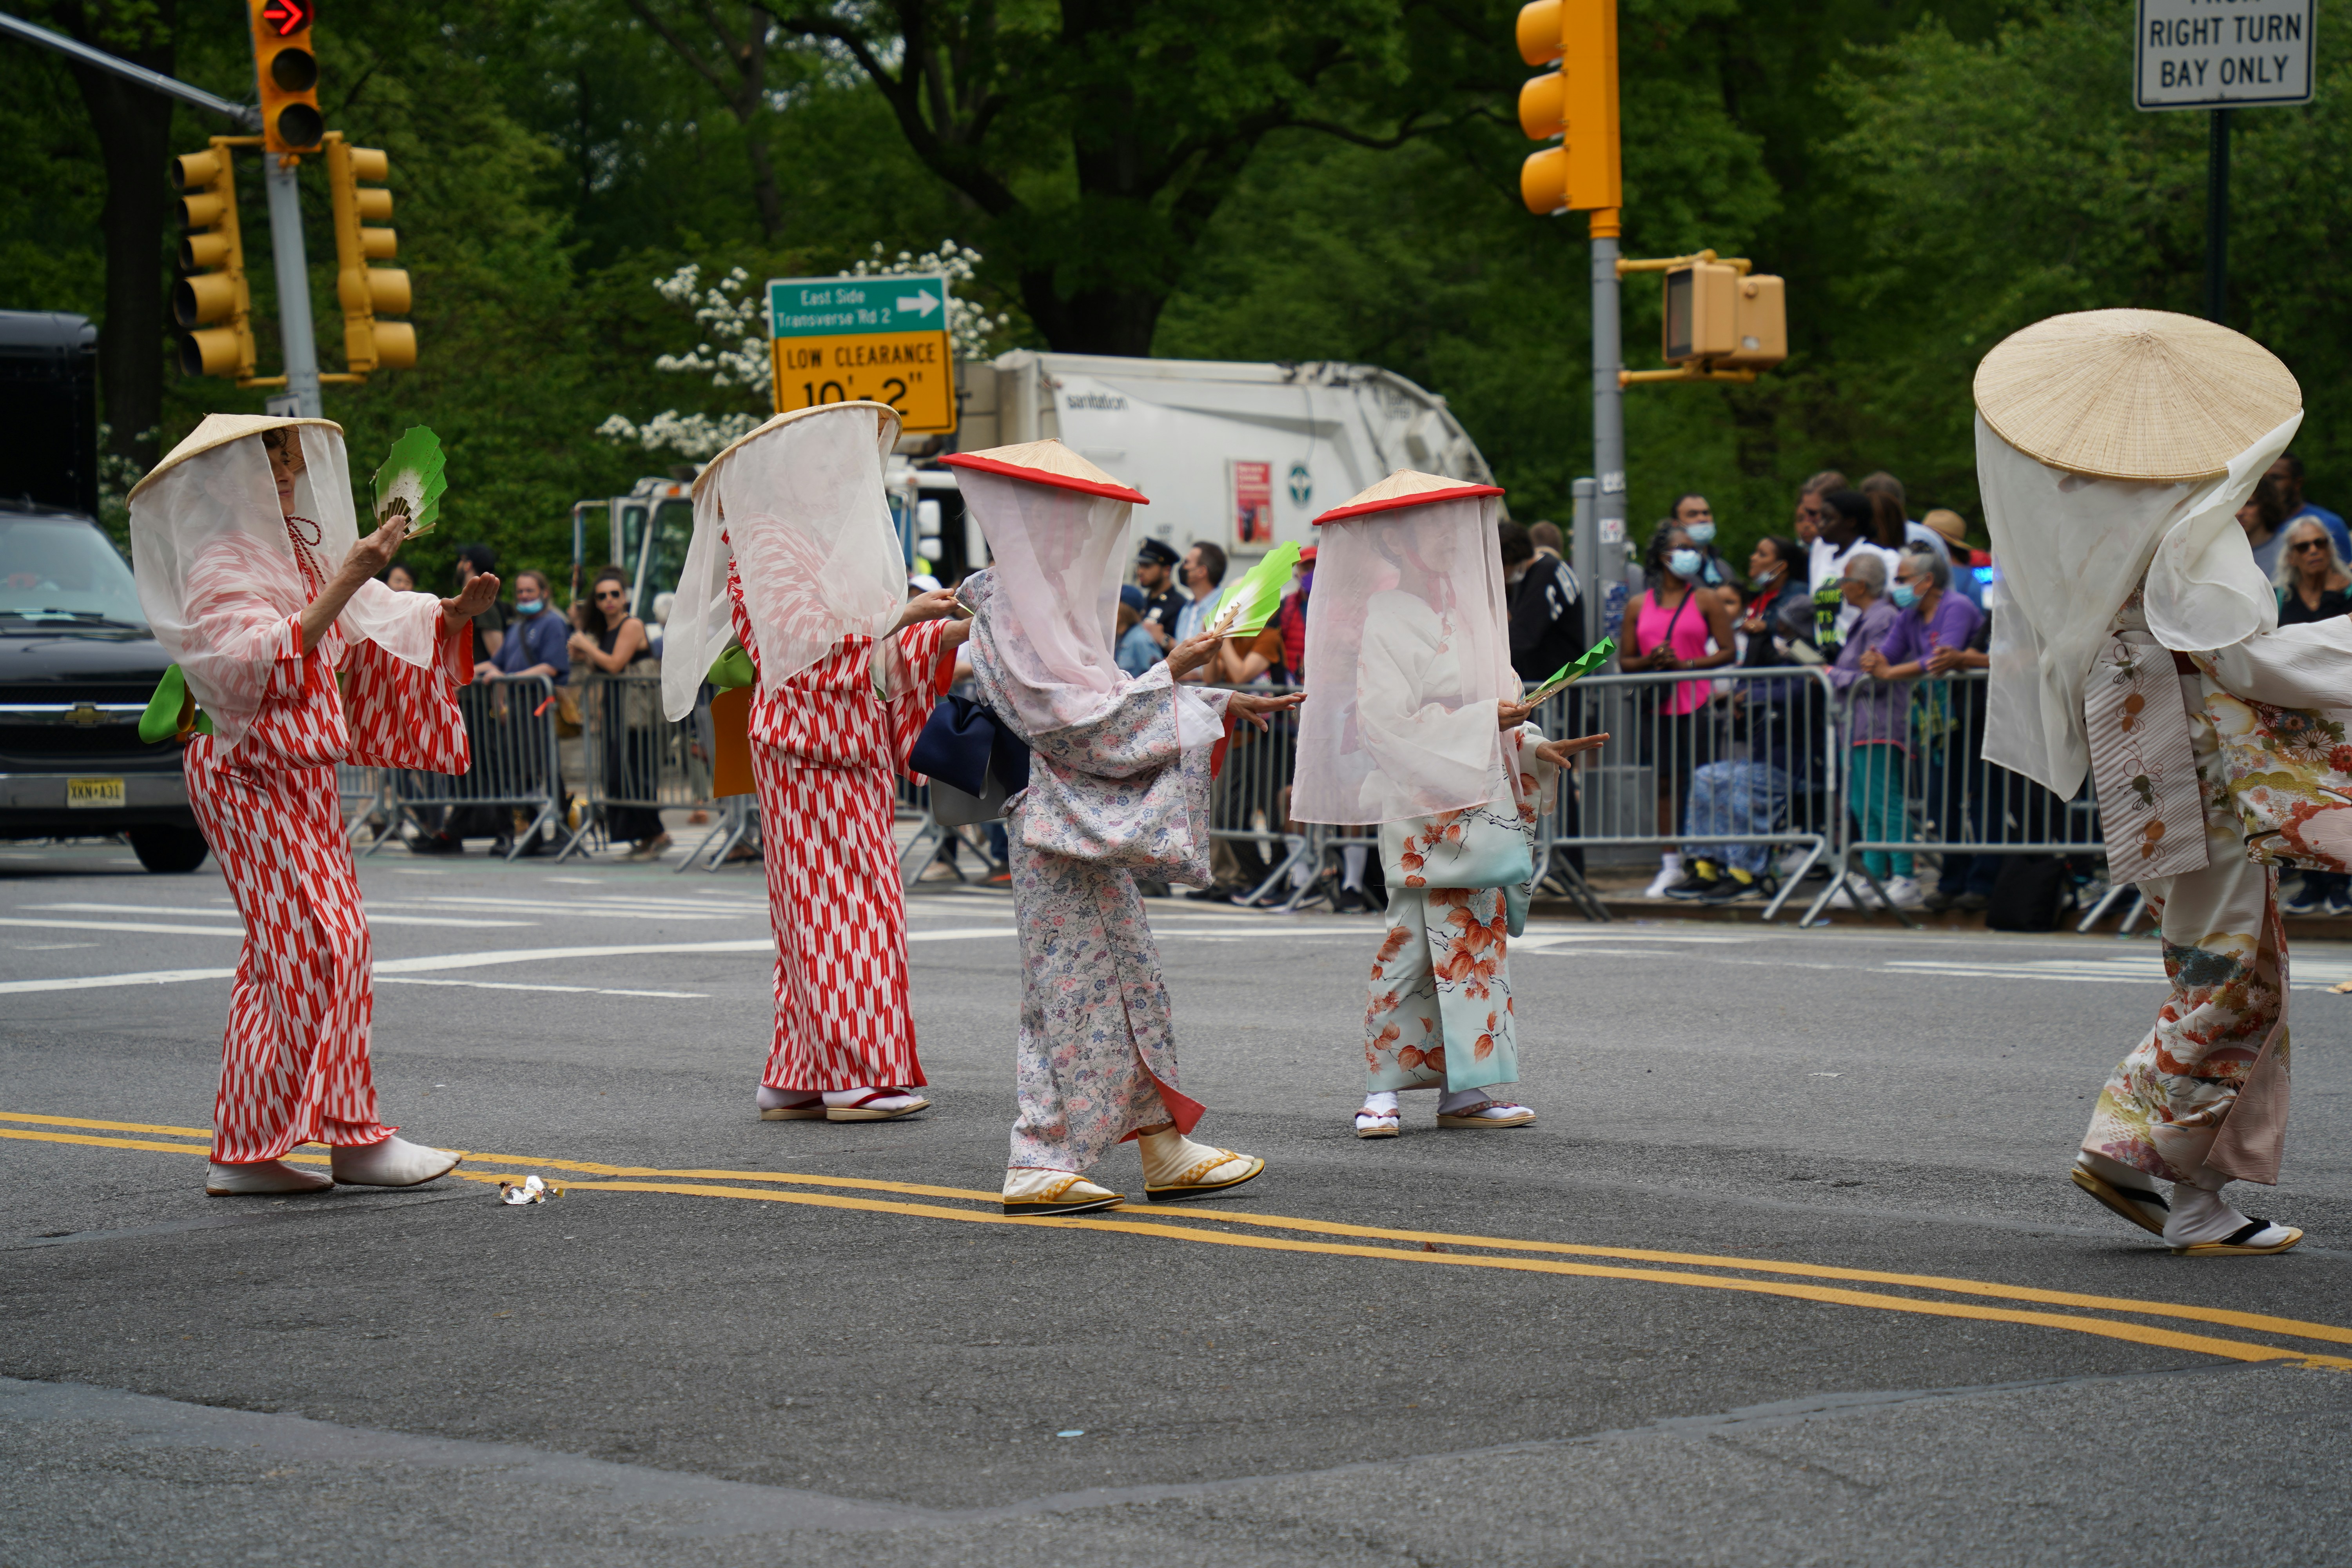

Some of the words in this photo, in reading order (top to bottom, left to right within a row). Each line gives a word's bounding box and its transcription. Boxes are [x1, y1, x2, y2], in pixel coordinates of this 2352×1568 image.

[2151, 18, 2223, 46] RIGHT
[2234, 14, 2301, 43] TURN
[2161, 59, 2208, 87] BAY
[2221, 56, 2289, 85] ONLY
[800, 289, 831, 306] East
[836, 288, 866, 305] Side
[777, 312, 854, 328] Transverse
[857, 308, 877, 324] Rd
[881, 308, 891, 324] 2
[787, 348, 822, 369] LOW
[835, 343, 935, 367] CLEARANCE
[1067, 390, 1129, 410] sanitation
